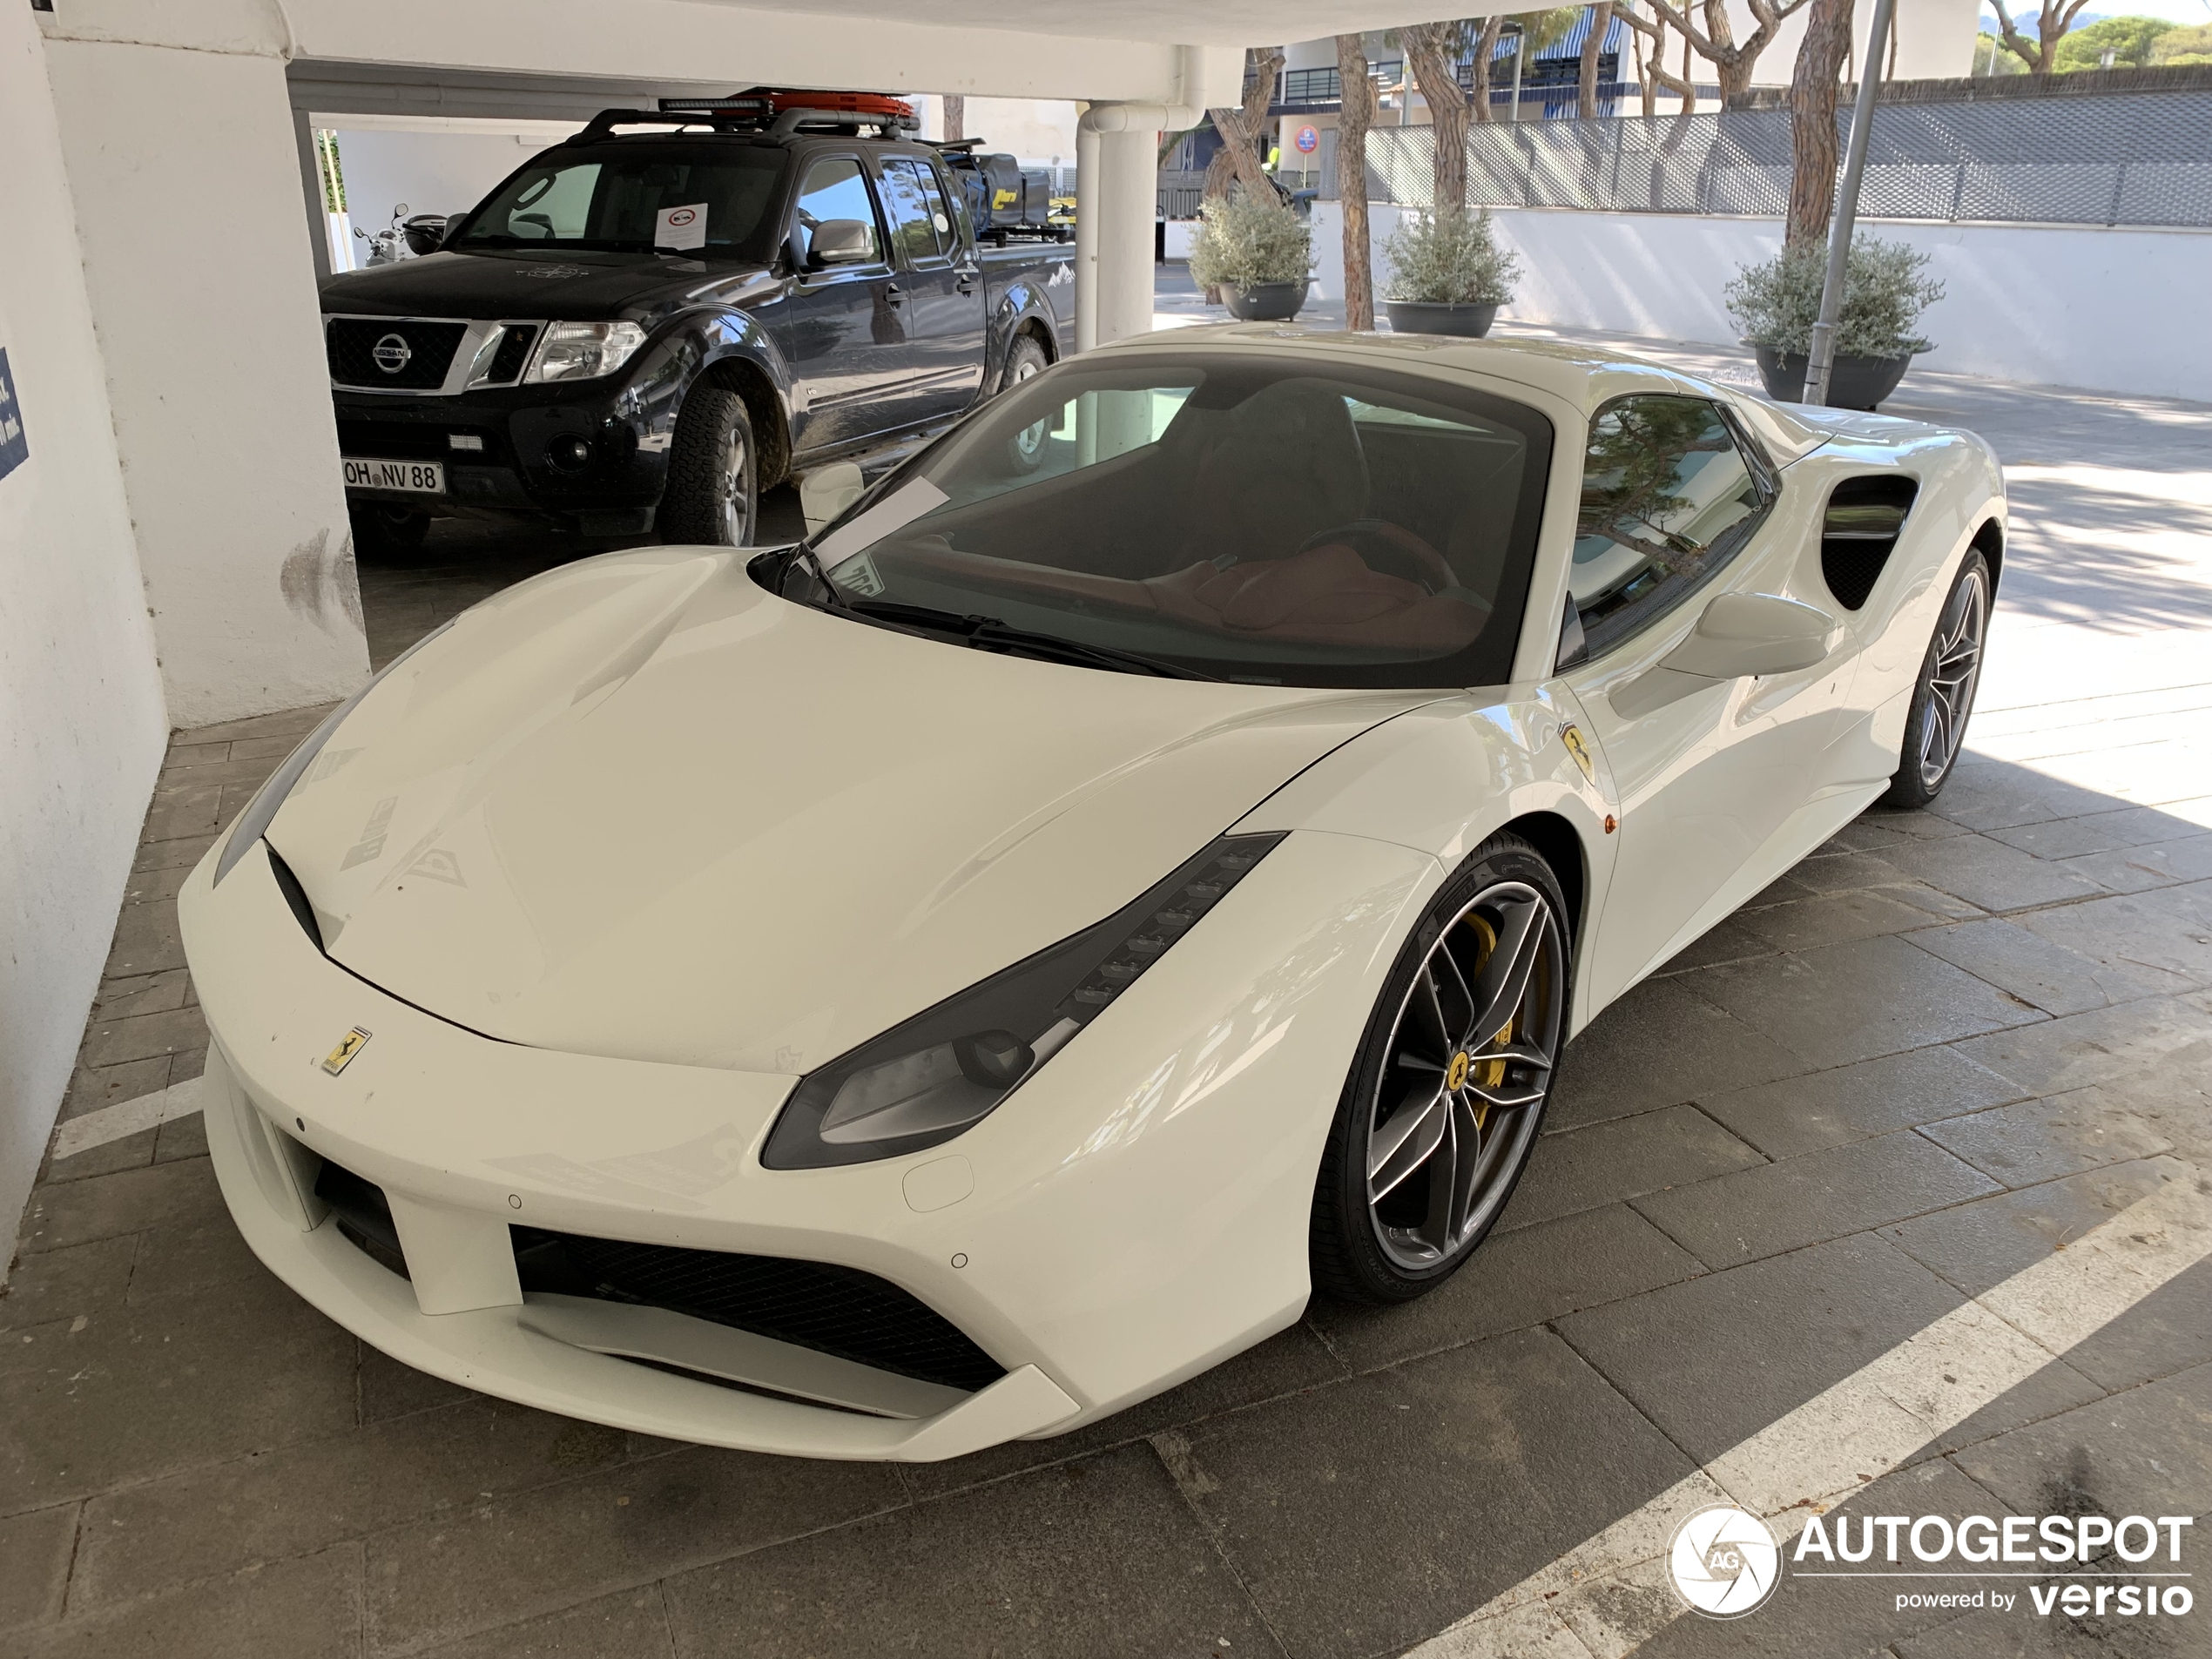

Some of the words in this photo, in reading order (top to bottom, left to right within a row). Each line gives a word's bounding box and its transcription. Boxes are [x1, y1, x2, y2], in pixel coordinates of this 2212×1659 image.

[374, 348, 405, 357] NISSAN
[345, 462, 372, 485] OH
[381, 463, 406, 488] NV
[411, 465, 436, 489] 88
